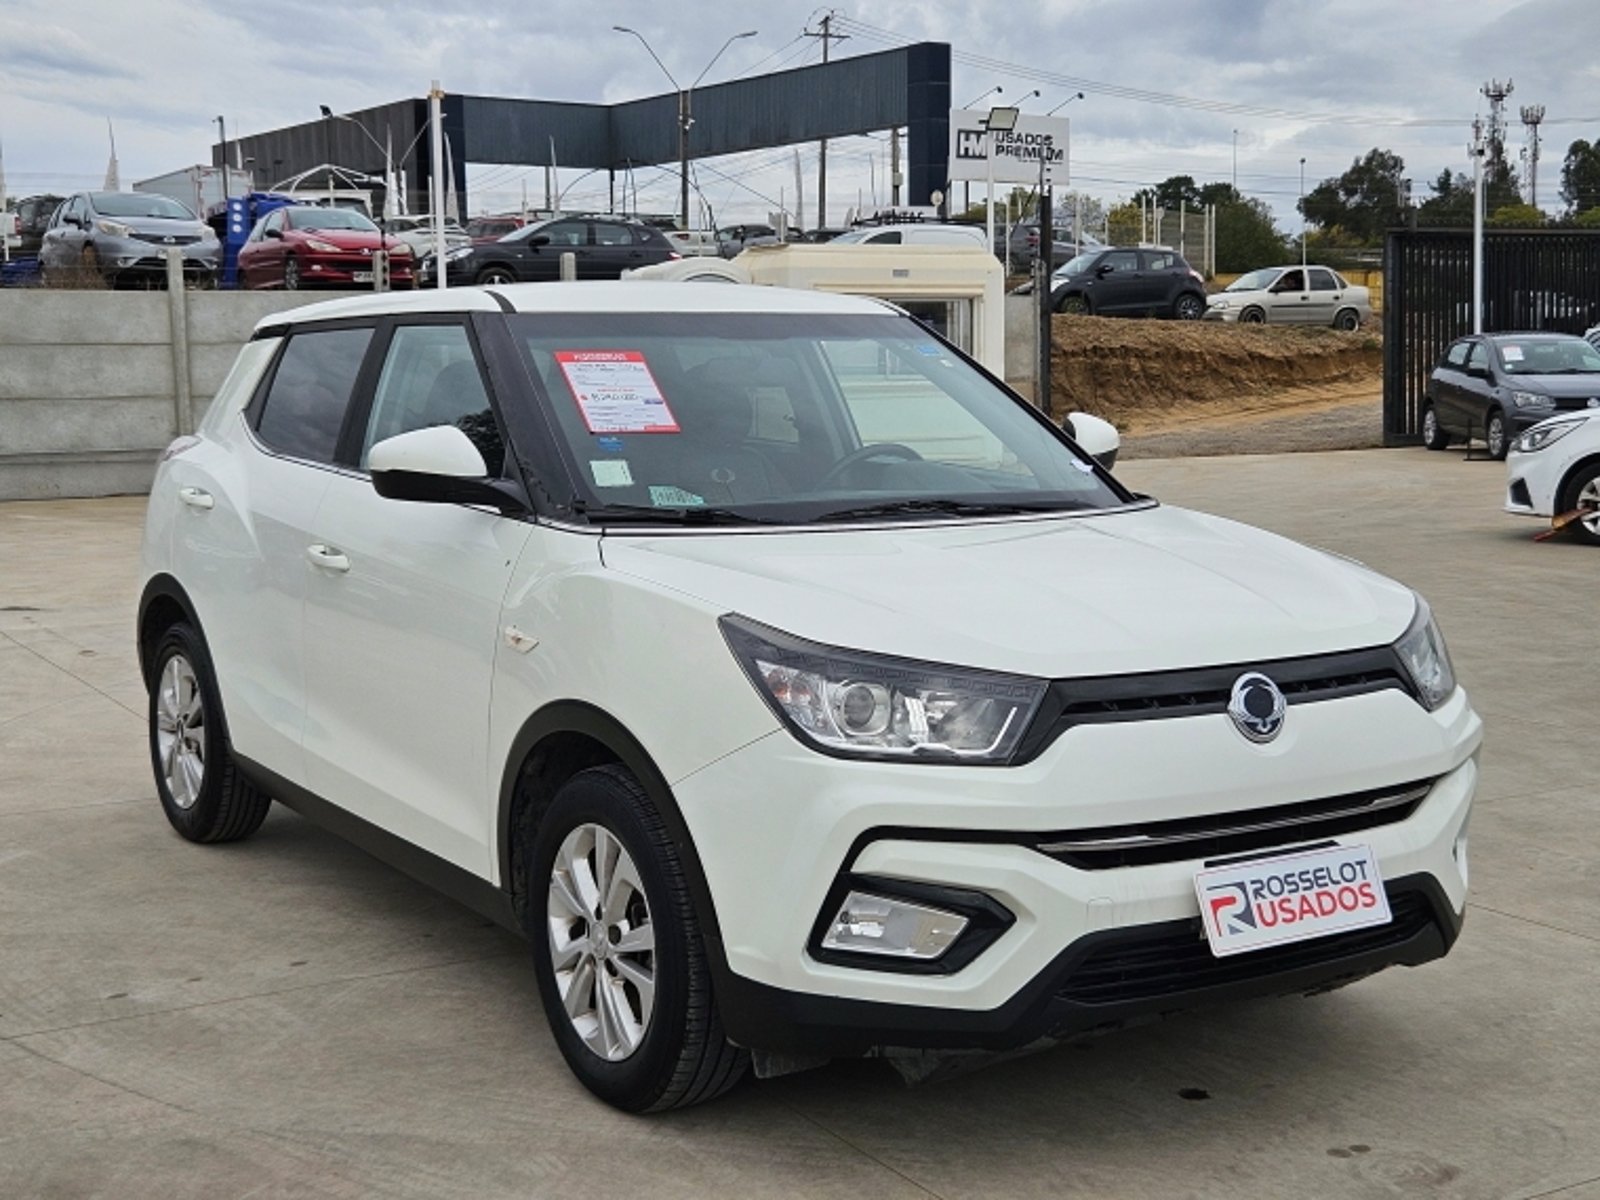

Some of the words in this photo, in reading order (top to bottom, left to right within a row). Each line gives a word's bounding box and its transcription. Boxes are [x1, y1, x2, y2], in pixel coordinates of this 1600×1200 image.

[995, 131, 1053, 146] USADOS
[1250, 861, 1367, 900] ROSSELOT
[1256, 883, 1376, 927] USADOS
